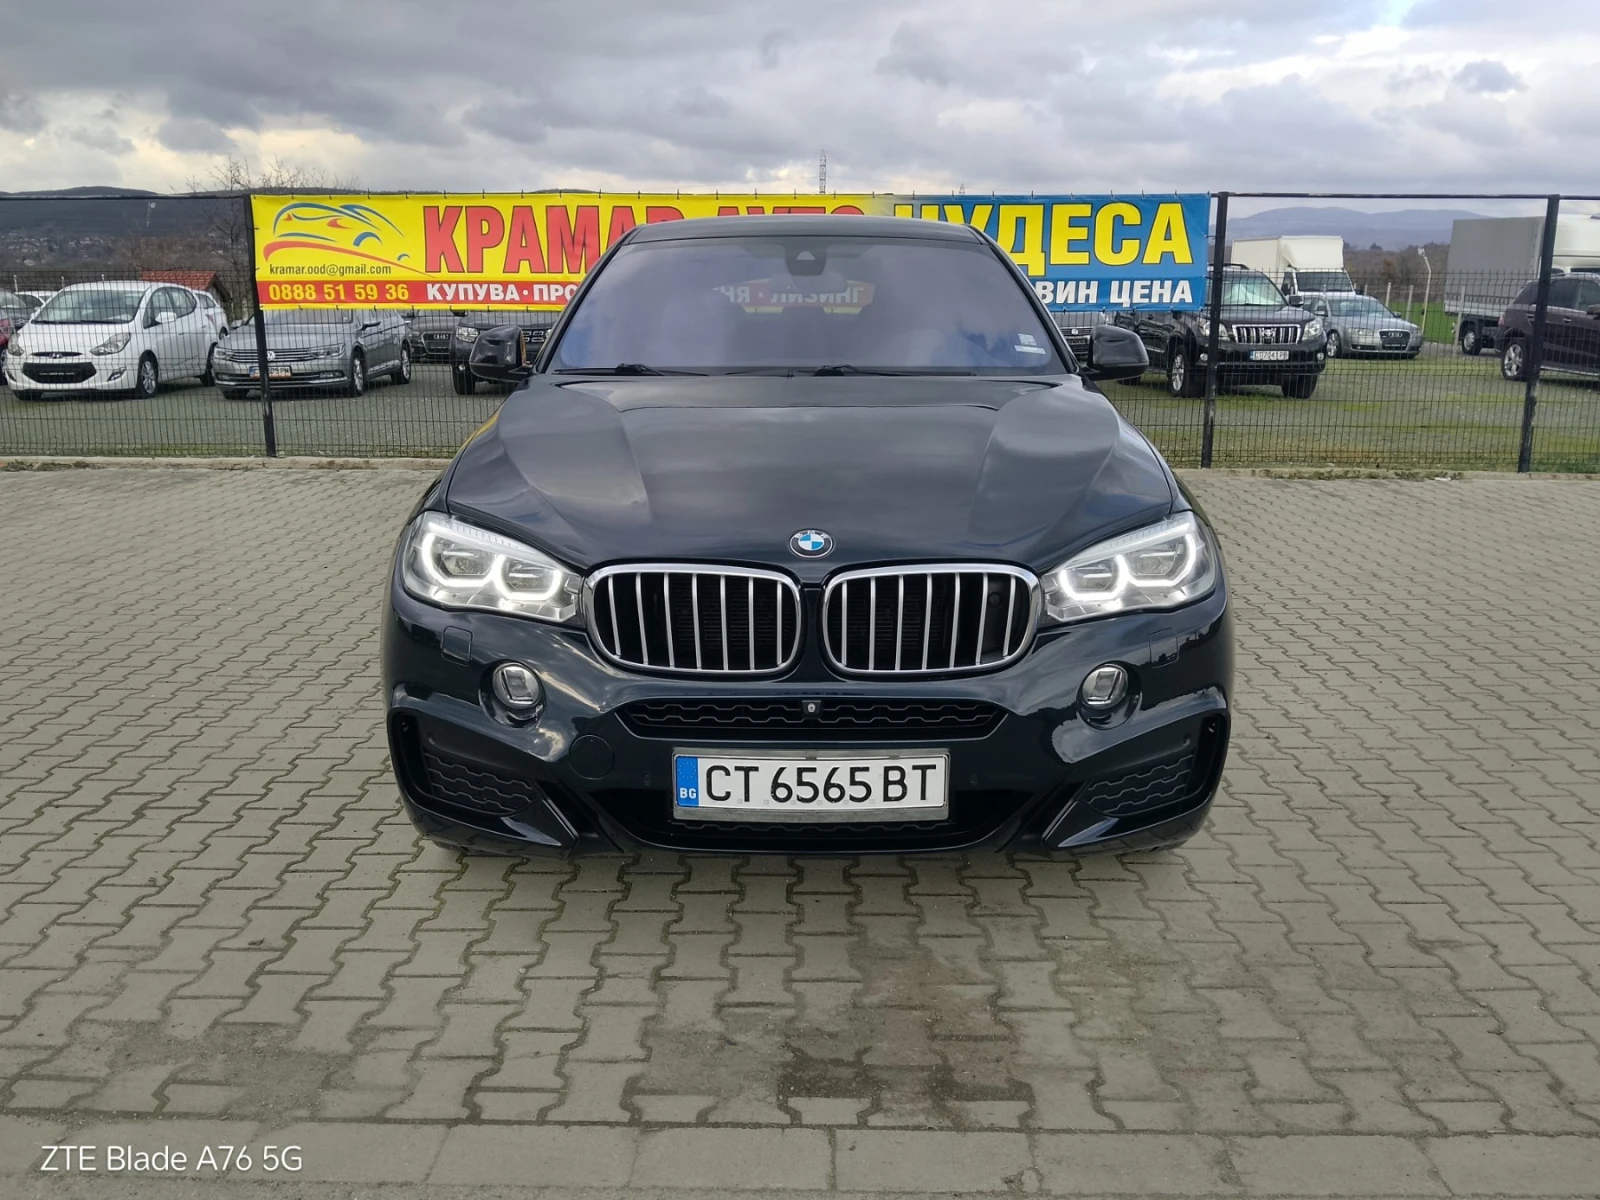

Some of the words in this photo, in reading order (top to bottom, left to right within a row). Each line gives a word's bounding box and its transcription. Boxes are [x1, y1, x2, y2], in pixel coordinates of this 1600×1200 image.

[423, 205, 684, 274] КРАМ
[893, 201, 1194, 277] ДЕСА
[269, 263, 392, 276] kramar.ood@gmail.com
[268, 283, 317, 301] 0888
[323, 283, 346, 301] 51
[354, 283, 378, 301] 59
[385, 283, 409, 301] 36
[426, 283, 520, 301] КУПУВА
[1035, 280, 1099, 304] ВИН
[1109, 279, 1193, 308] ЦЕНА
[679, 787, 697, 799] BG
[705, 765, 760, 803] CT
[770, 766, 872, 804] 6565
